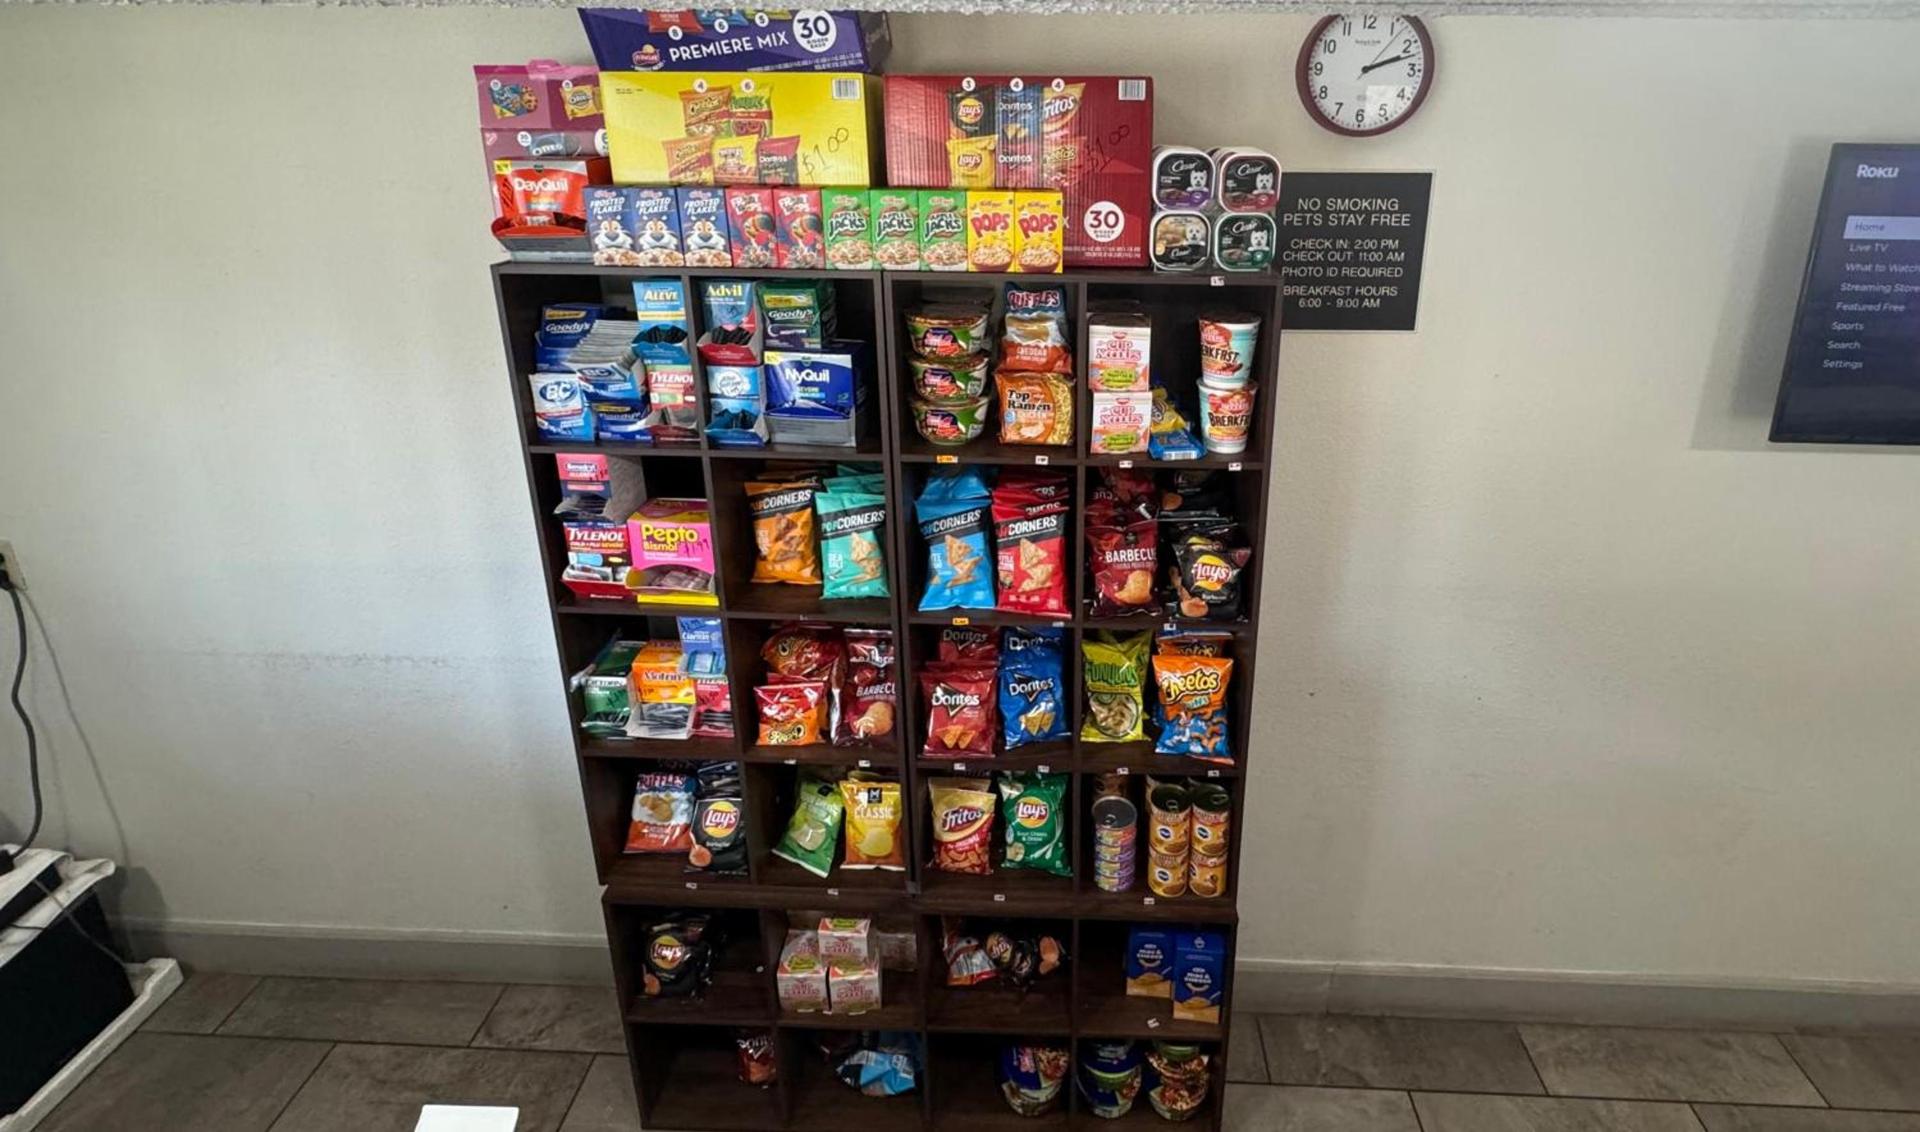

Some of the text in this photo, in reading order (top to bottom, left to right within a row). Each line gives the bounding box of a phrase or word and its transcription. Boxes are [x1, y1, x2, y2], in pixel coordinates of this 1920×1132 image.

[797, 15, 831, 39] 30
[1363, 14, 1377, 29] 12
[1343, 21, 1352, 36] 11
[1390, 21, 1395, 36] 1
[669, 37, 754, 62] PREMIERE
[757, 31, 789, 50] MIX
[1323, 39, 1336, 54] 10
[1402, 39, 1412, 54] 2
[1314, 62, 1323, 76] 9
[1407, 63, 1416, 77] 3
[964, 79, 973, 90] 3
[1012, 79, 1021, 91] 4
[1054, 79, 1063, 91] 4
[1319, 85, 1328, 99] 8
[1396, 87, 1405, 100] 4
[999, 101, 1033, 112] Doritos
[1335, 102, 1344, 116] 7
[1378, 103, 1387, 117] 5
[1355, 109, 1365, 123] 6
[998, 154, 1033, 164] Doritos
[1171, 160, 1199, 172] Cesar
[513, 177, 569, 193] DayQuil
[590, 197, 625, 208] FROSTED
[635, 197, 671, 208] FROSTED
[684, 197, 720, 208] FROSTED
[1297, 198, 1400, 211] NO SMOKING
[593, 204, 622, 215] FLAKES
[639, 204, 668, 215] FLAKES
[686, 204, 717, 215] FLAKES
[971, 213, 1010, 238] POPS
[1089, 210, 1119, 228] 30
[1283, 213, 1411, 226] PETS STAY FREE
[829, 216, 865, 241] JACKS
[877, 216, 914, 241] JACKS
[925, 216, 962, 241] JACKS
[1018, 213, 1059, 239] POPS
[1854, 222, 1885, 231] Home
[1290, 239, 1333, 250] CHECK
[1354, 239, 1378, 250] 2:00
[1380, 239, 1400, 250] PM
[1849, 243, 1889, 252] Live TV
[1282, 251, 1325, 262] CHECK
[1359, 251, 1384, 262] 11:00
[1386, 251, 1405, 262] AM
[1281, 266, 1404, 278] PHOTO ID REQUIRED
[1845, 263, 1920, 273] What to Watch
[706, 285, 743, 297] Advil
[1283, 285, 1399, 297] BREAKFAST HOURS
[1840, 283, 1892, 294] Streaming
[644, 290, 678, 301] ALEVE
[1298, 298, 1322, 309] 6:00
[1335, 298, 1361, 309] 9:00
[1362, 298, 1382, 309] AM
[1836, 302, 1905, 312] Featured Free
[769, 309, 814, 321] Goody's
[545, 323, 590, 333] Goody's
[1832, 322, 1864, 332] Sports
[1827, 341, 1860, 350] Search
[1823, 360, 1863, 371] Settings
[785, 368, 830, 383] NyQuil
[546, 384, 572, 400] BC
[1008, 388, 1030, 402] Top
[1007, 400, 1051, 411] Ramen
[821, 510, 886, 533] POPCORNERS
[568, 528, 625, 541] TYLENOL
[641, 523, 698, 544] Pepto
[643, 541, 678, 551] Bismol
[943, 628, 988, 641] Doritos
[1009, 678, 1054, 696] Doritos
[1161, 671, 1218, 700] Cheetos
[931, 692, 980, 706] Doritos
[942, 807, 984, 831] Fritos
